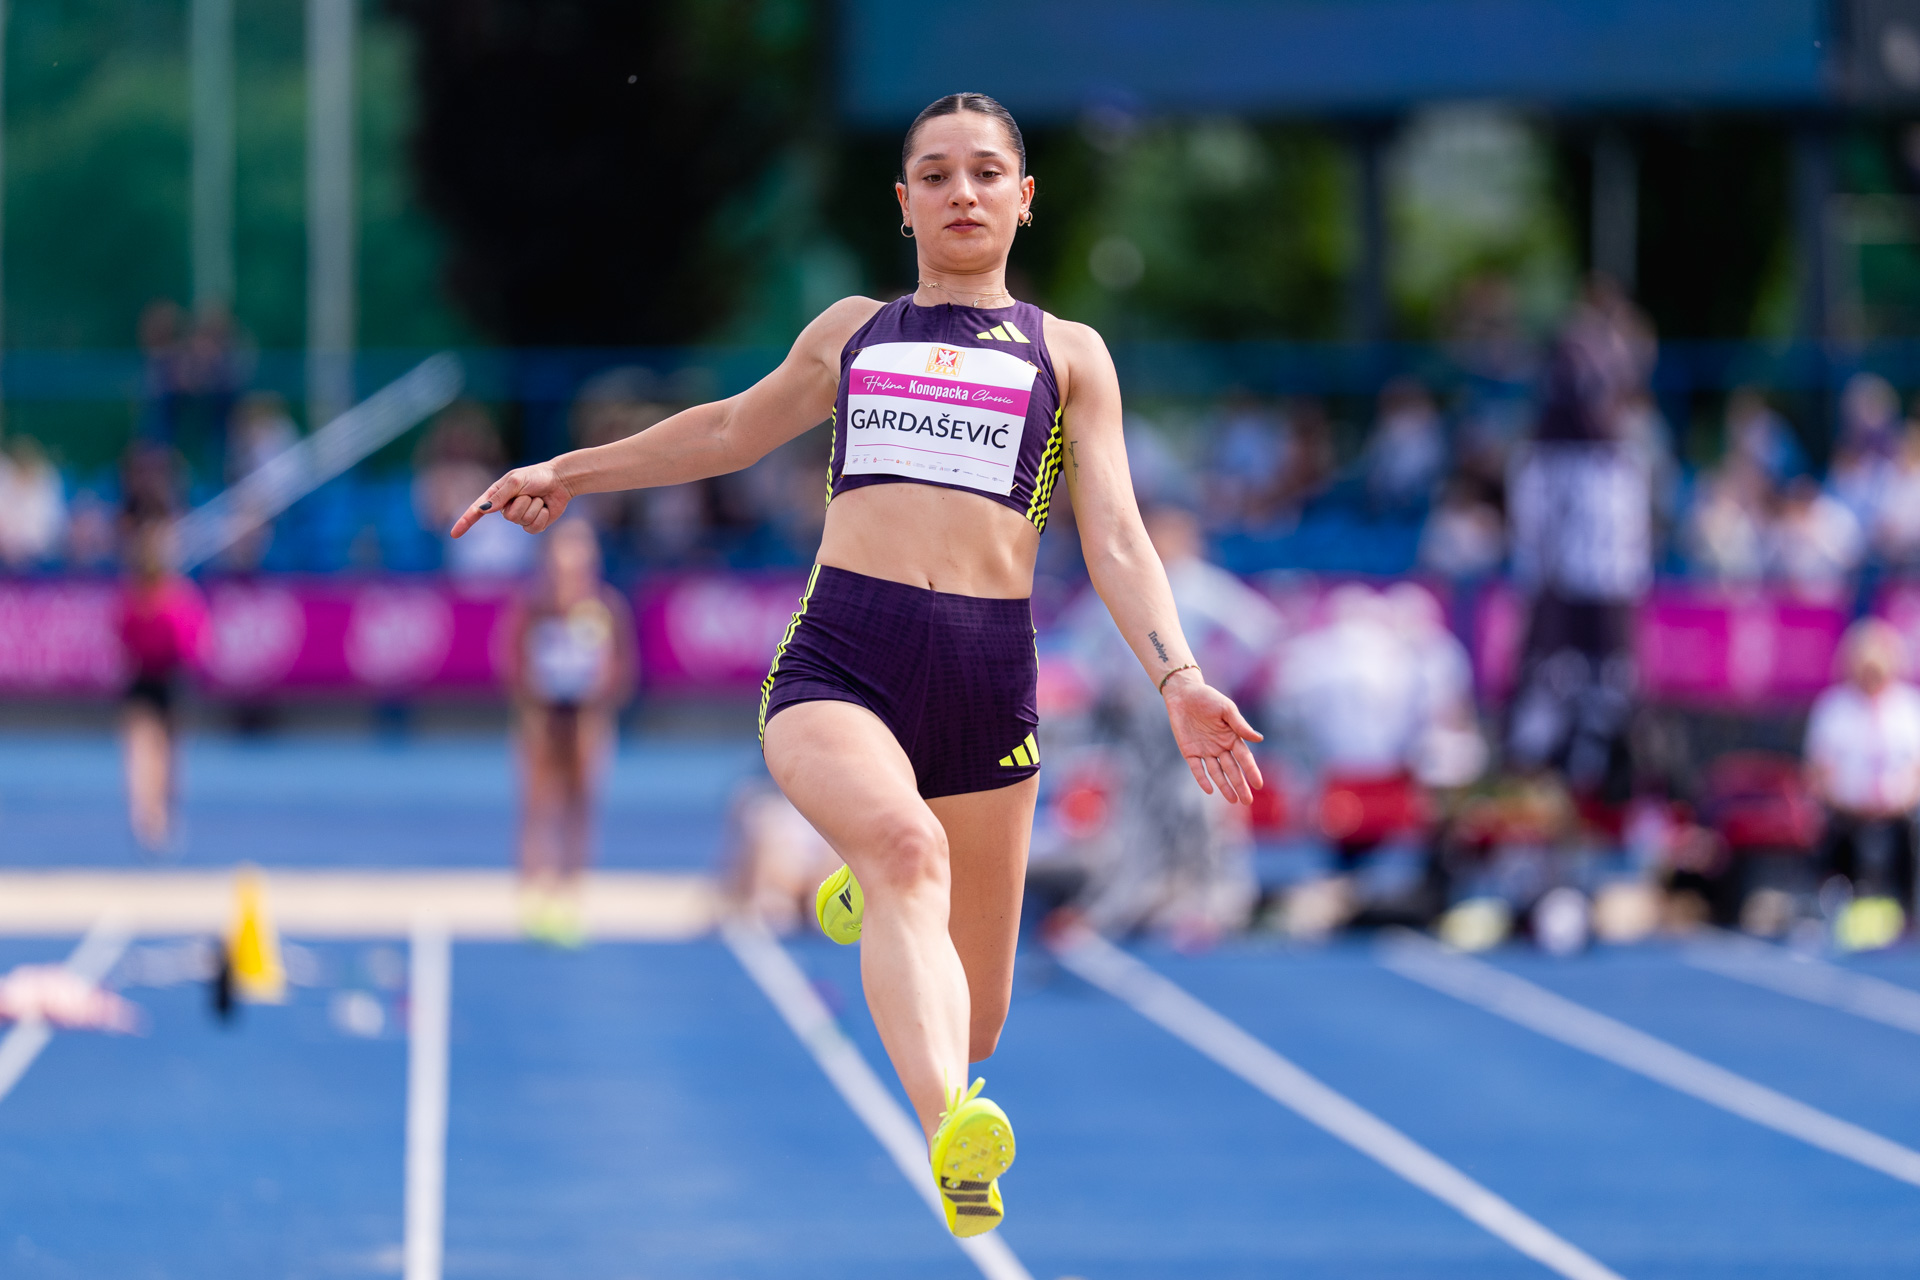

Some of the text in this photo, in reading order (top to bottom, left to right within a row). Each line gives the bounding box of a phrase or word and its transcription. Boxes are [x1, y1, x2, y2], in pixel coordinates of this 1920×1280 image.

[862, 375, 1014, 404] Halina Konopacka Classic
[851, 408, 1010, 449] GARDAŠEVIĆ
